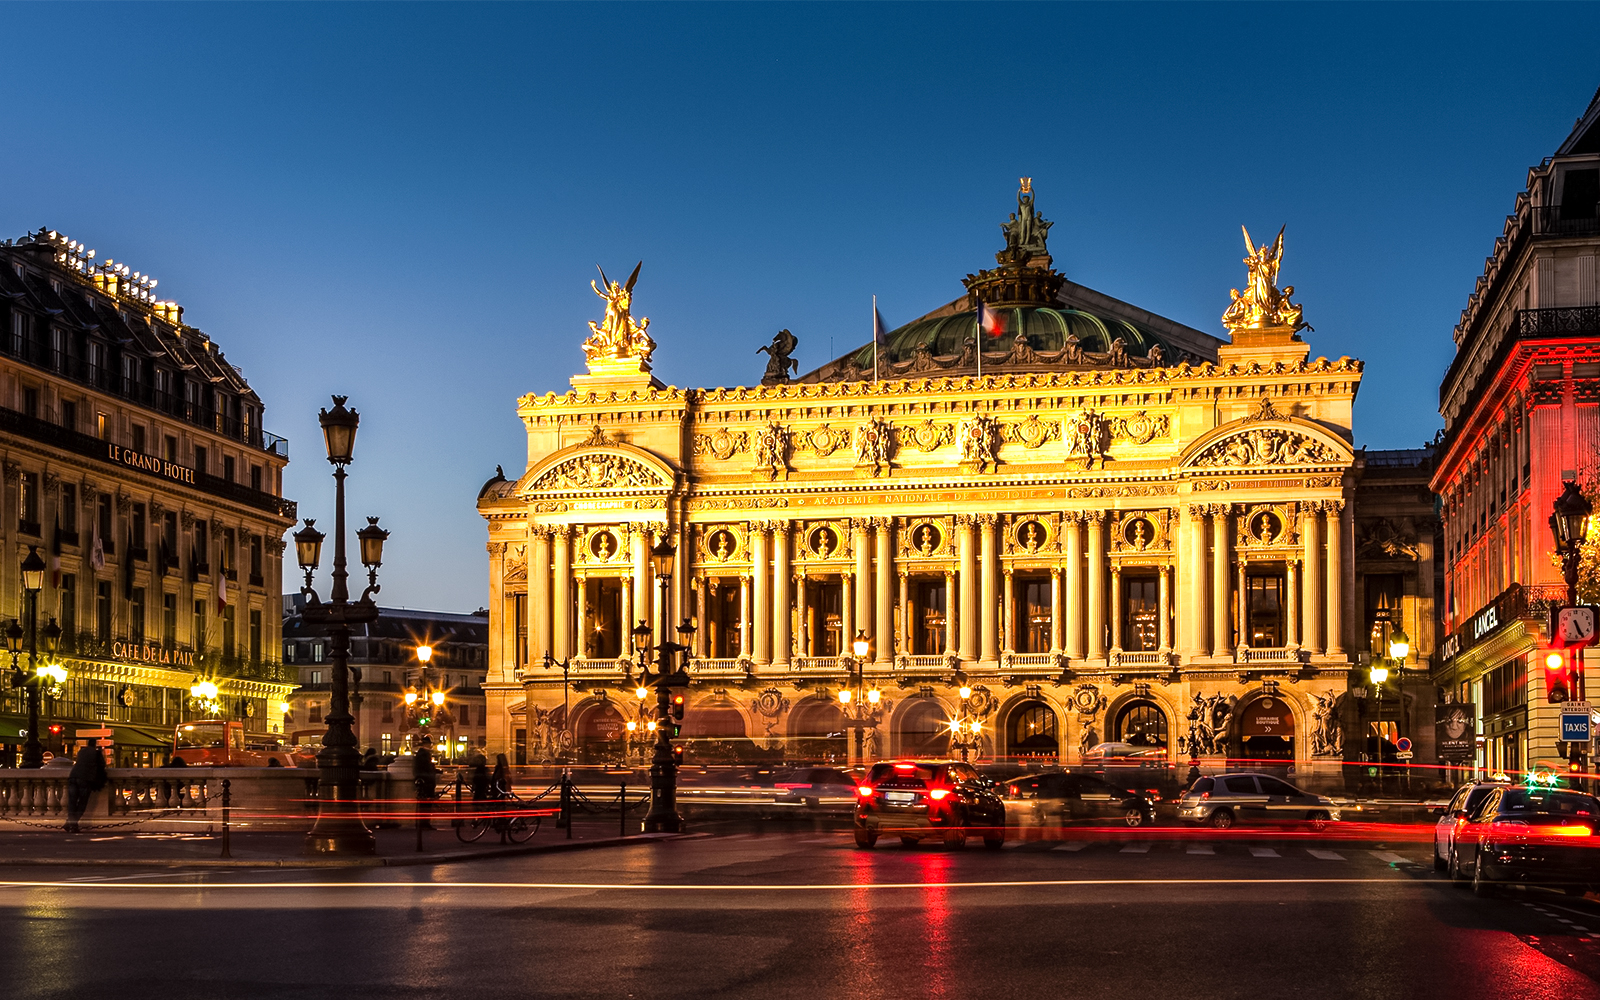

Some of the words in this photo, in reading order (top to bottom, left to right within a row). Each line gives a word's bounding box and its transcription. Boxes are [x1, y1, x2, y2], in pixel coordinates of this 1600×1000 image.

[108, 444, 120, 461] LE
[123, 449, 160, 473] GRAND
[164, 461, 195, 485] HOTEL
[814, 495, 874, 505] ACADEMIE
[885, 493, 943, 503] NATIONALE
[954, 492, 970, 501] DE
[981, 490, 1037, 500] MUSIQUE
[1474, 606, 1498, 639] LANCEL
[113, 641, 139, 660] CAFE
[143, 645, 156, 661] DE
[158, 648, 170, 664] LA
[173, 650, 195, 666] PAIX
[1564, 723, 1588, 732] TAXIS
